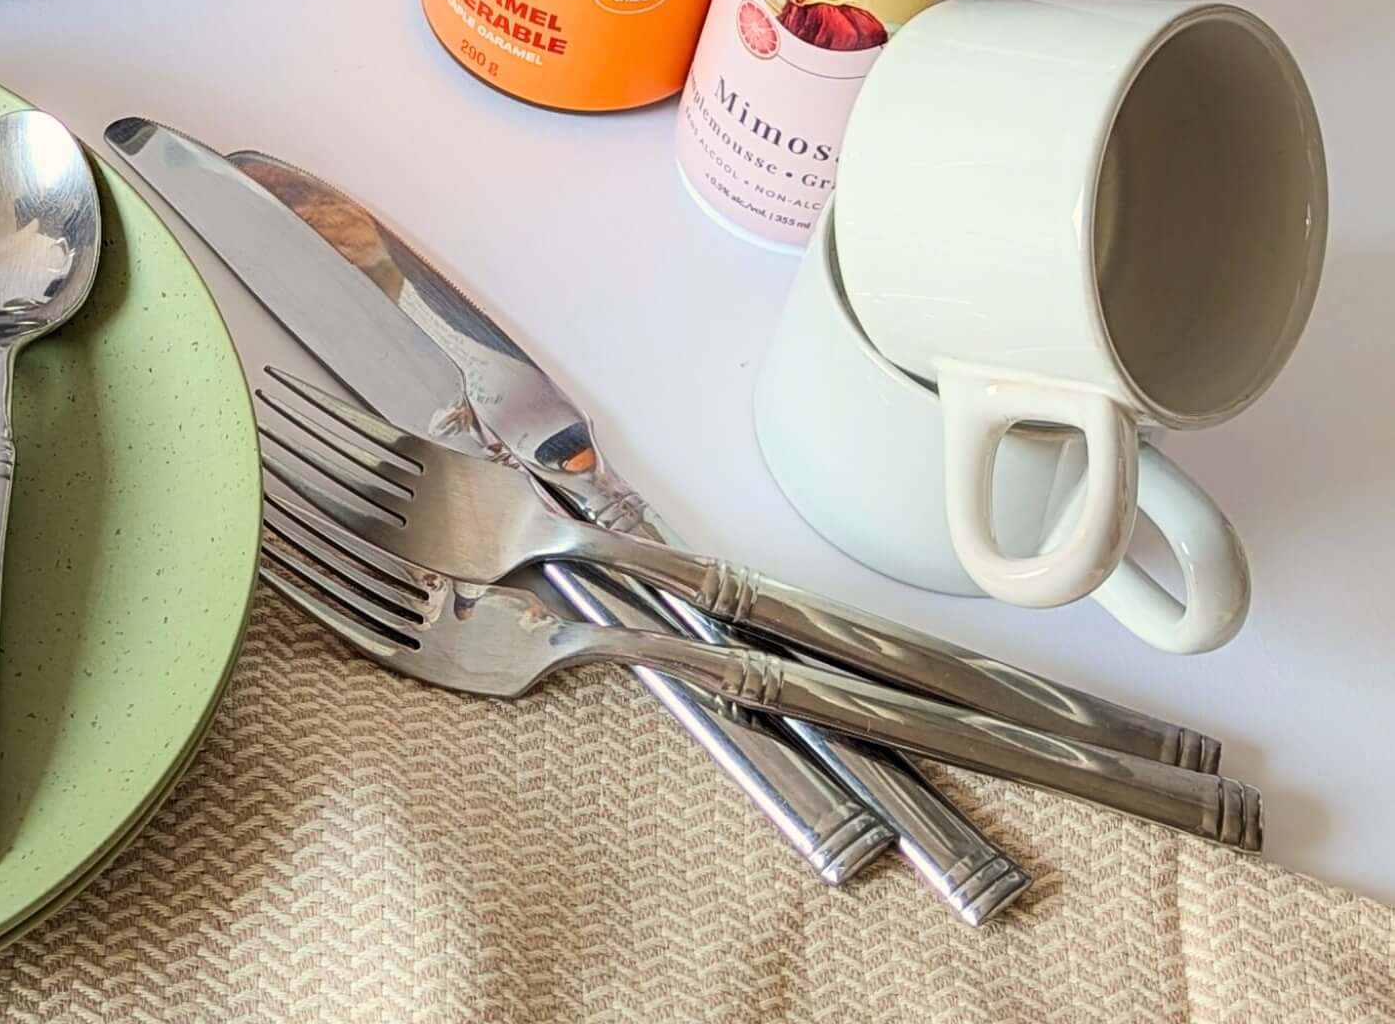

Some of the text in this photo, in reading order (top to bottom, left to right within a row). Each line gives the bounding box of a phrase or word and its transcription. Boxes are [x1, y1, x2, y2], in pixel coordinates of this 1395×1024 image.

[477, 24, 543, 66] CARAMEL
[488, 61, 500, 77] g
[714, 75, 839, 163] Mimos
[699, 138, 823, 211] ALCOOL NON-ALC
[801, 173, 835, 191] Gr
[775, 214, 795, 226] 355
[796, 221, 812, 230] ml
